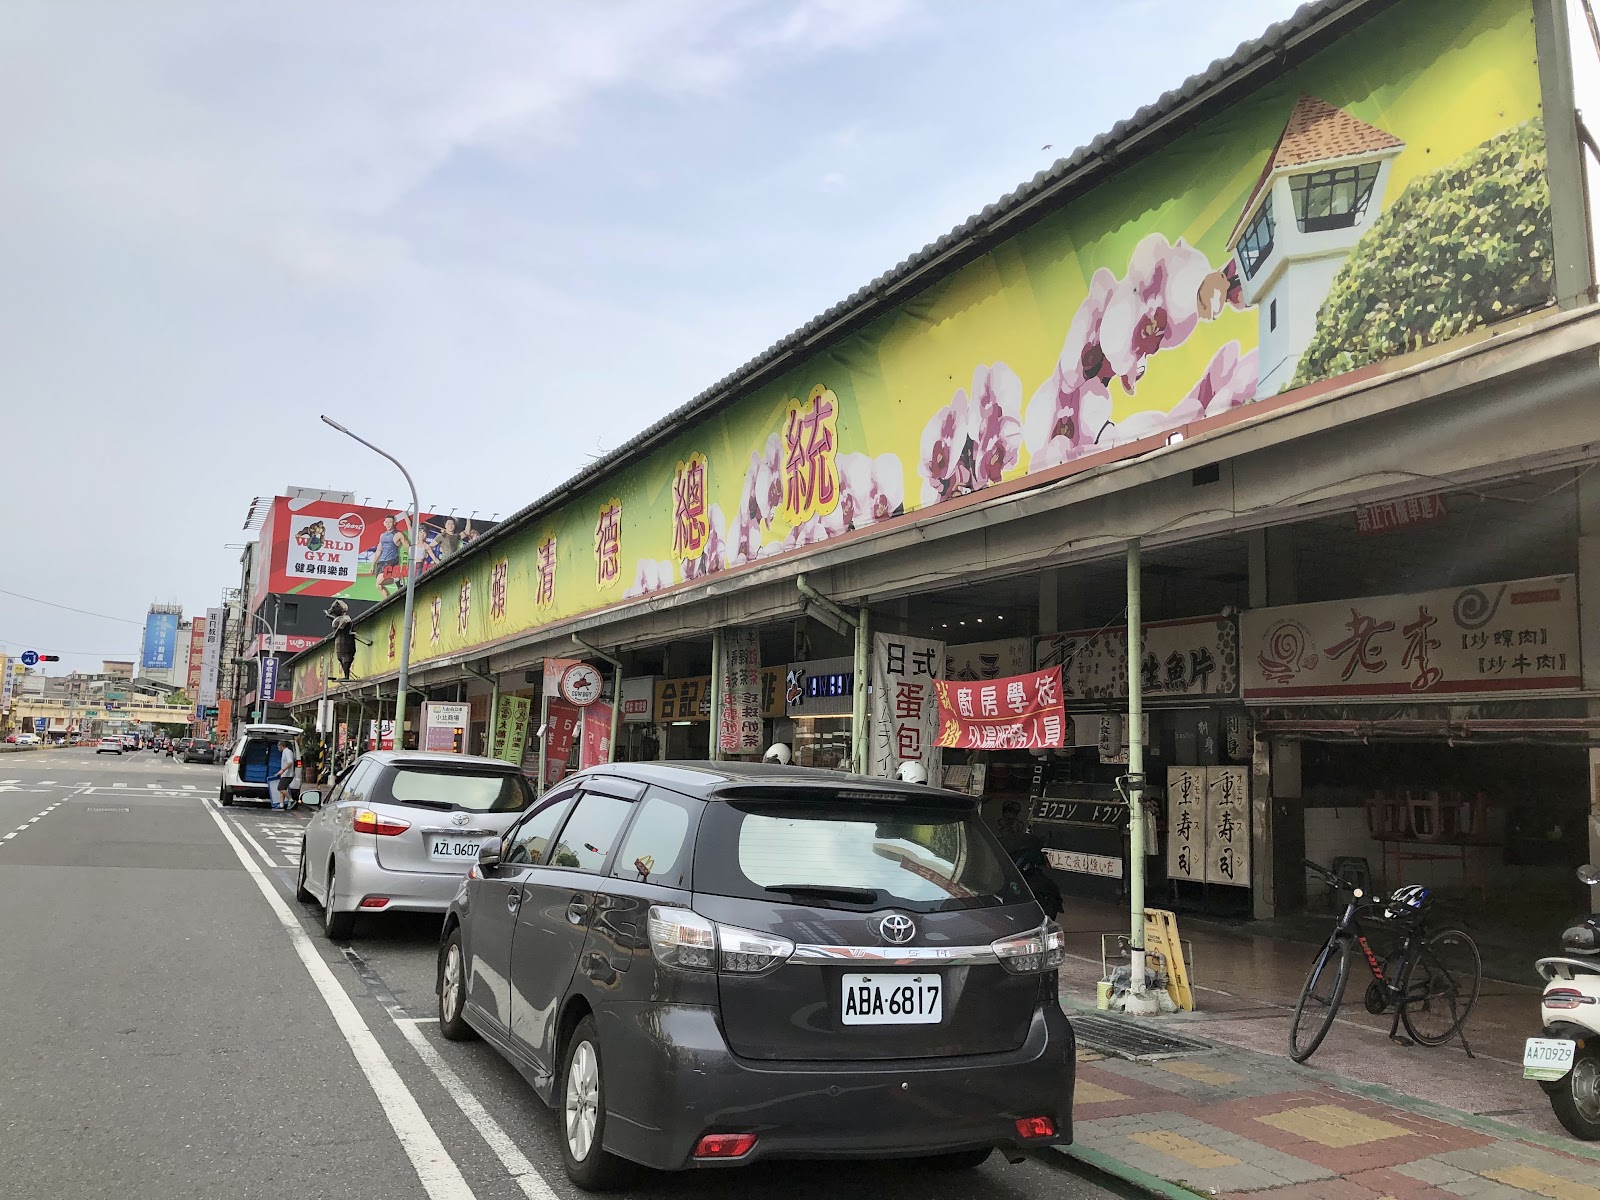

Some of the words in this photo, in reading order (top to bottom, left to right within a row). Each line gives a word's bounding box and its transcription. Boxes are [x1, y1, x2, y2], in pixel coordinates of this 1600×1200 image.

[338, 519, 364, 531] Sport
[295, 562, 349, 577] 健身俱樂部
[304, 551, 341, 563] GYM
[886, 642, 937, 679] 日式
[957, 675, 1057, 717] 廚房學徒
[563, 719, 572, 731] 5
[877, 683, 892, 779] オムライ
[896, 681, 925, 760] 蛋包
[963, 715, 1061, 748] 外場服務人員
[1039, 801, 1077, 819] ヨウコソ
